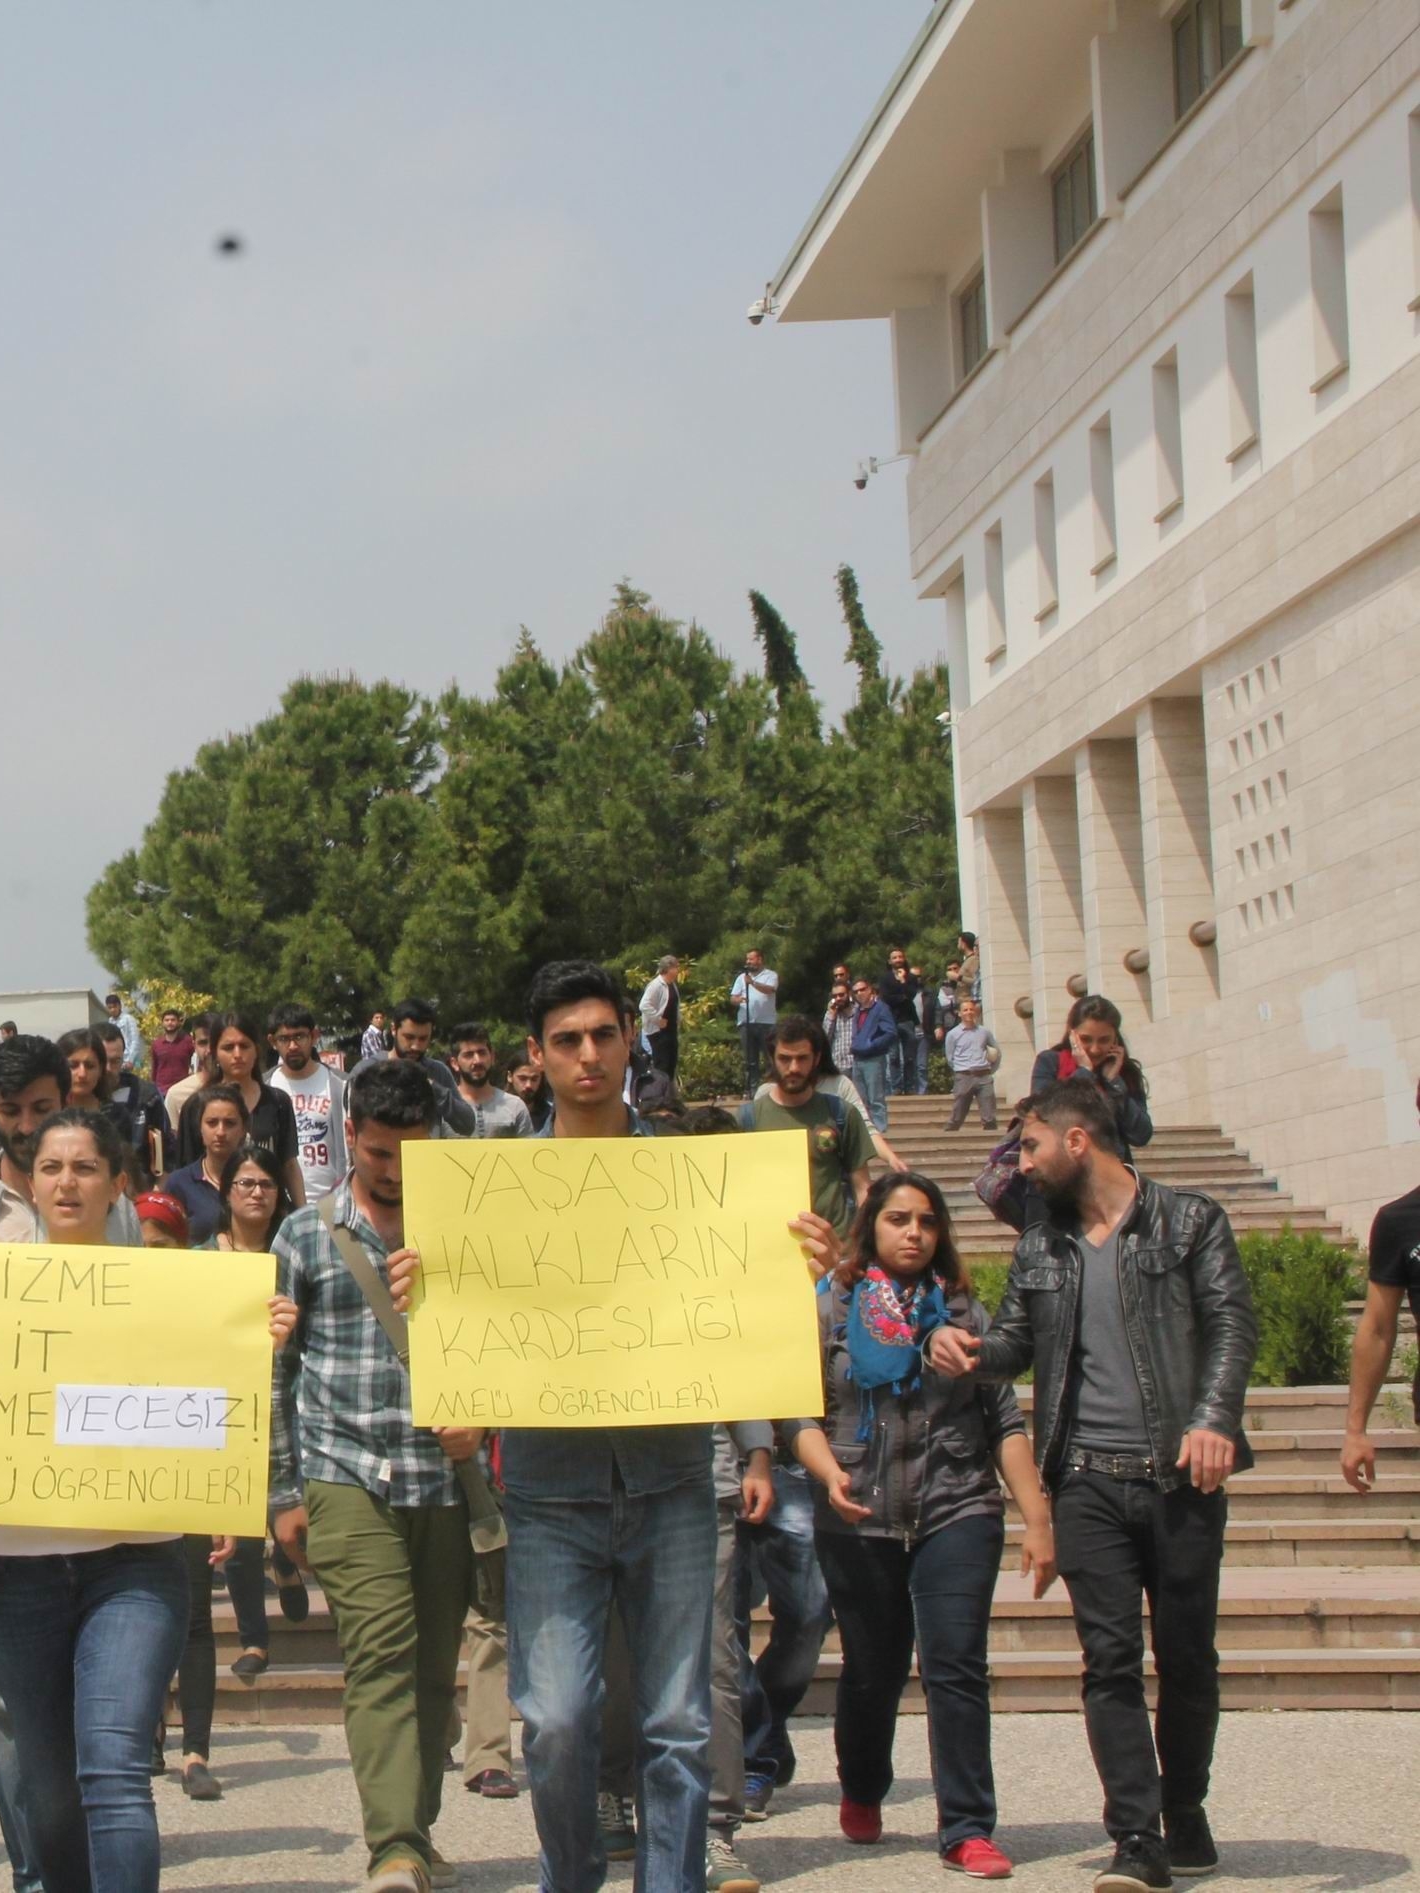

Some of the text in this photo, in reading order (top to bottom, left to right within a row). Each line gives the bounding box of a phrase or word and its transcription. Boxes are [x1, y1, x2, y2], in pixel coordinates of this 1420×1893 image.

[303, 1143, 328, 1167] 99
[443, 1148, 728, 1216] YAŞASIN
[412, 1221, 749, 1298] HALKLARIN
[435, 1289, 743, 1367] KARDEŞLİĞİ
[430, 1373, 720, 1420] MEÜ ÖĞRENCİLERİ
